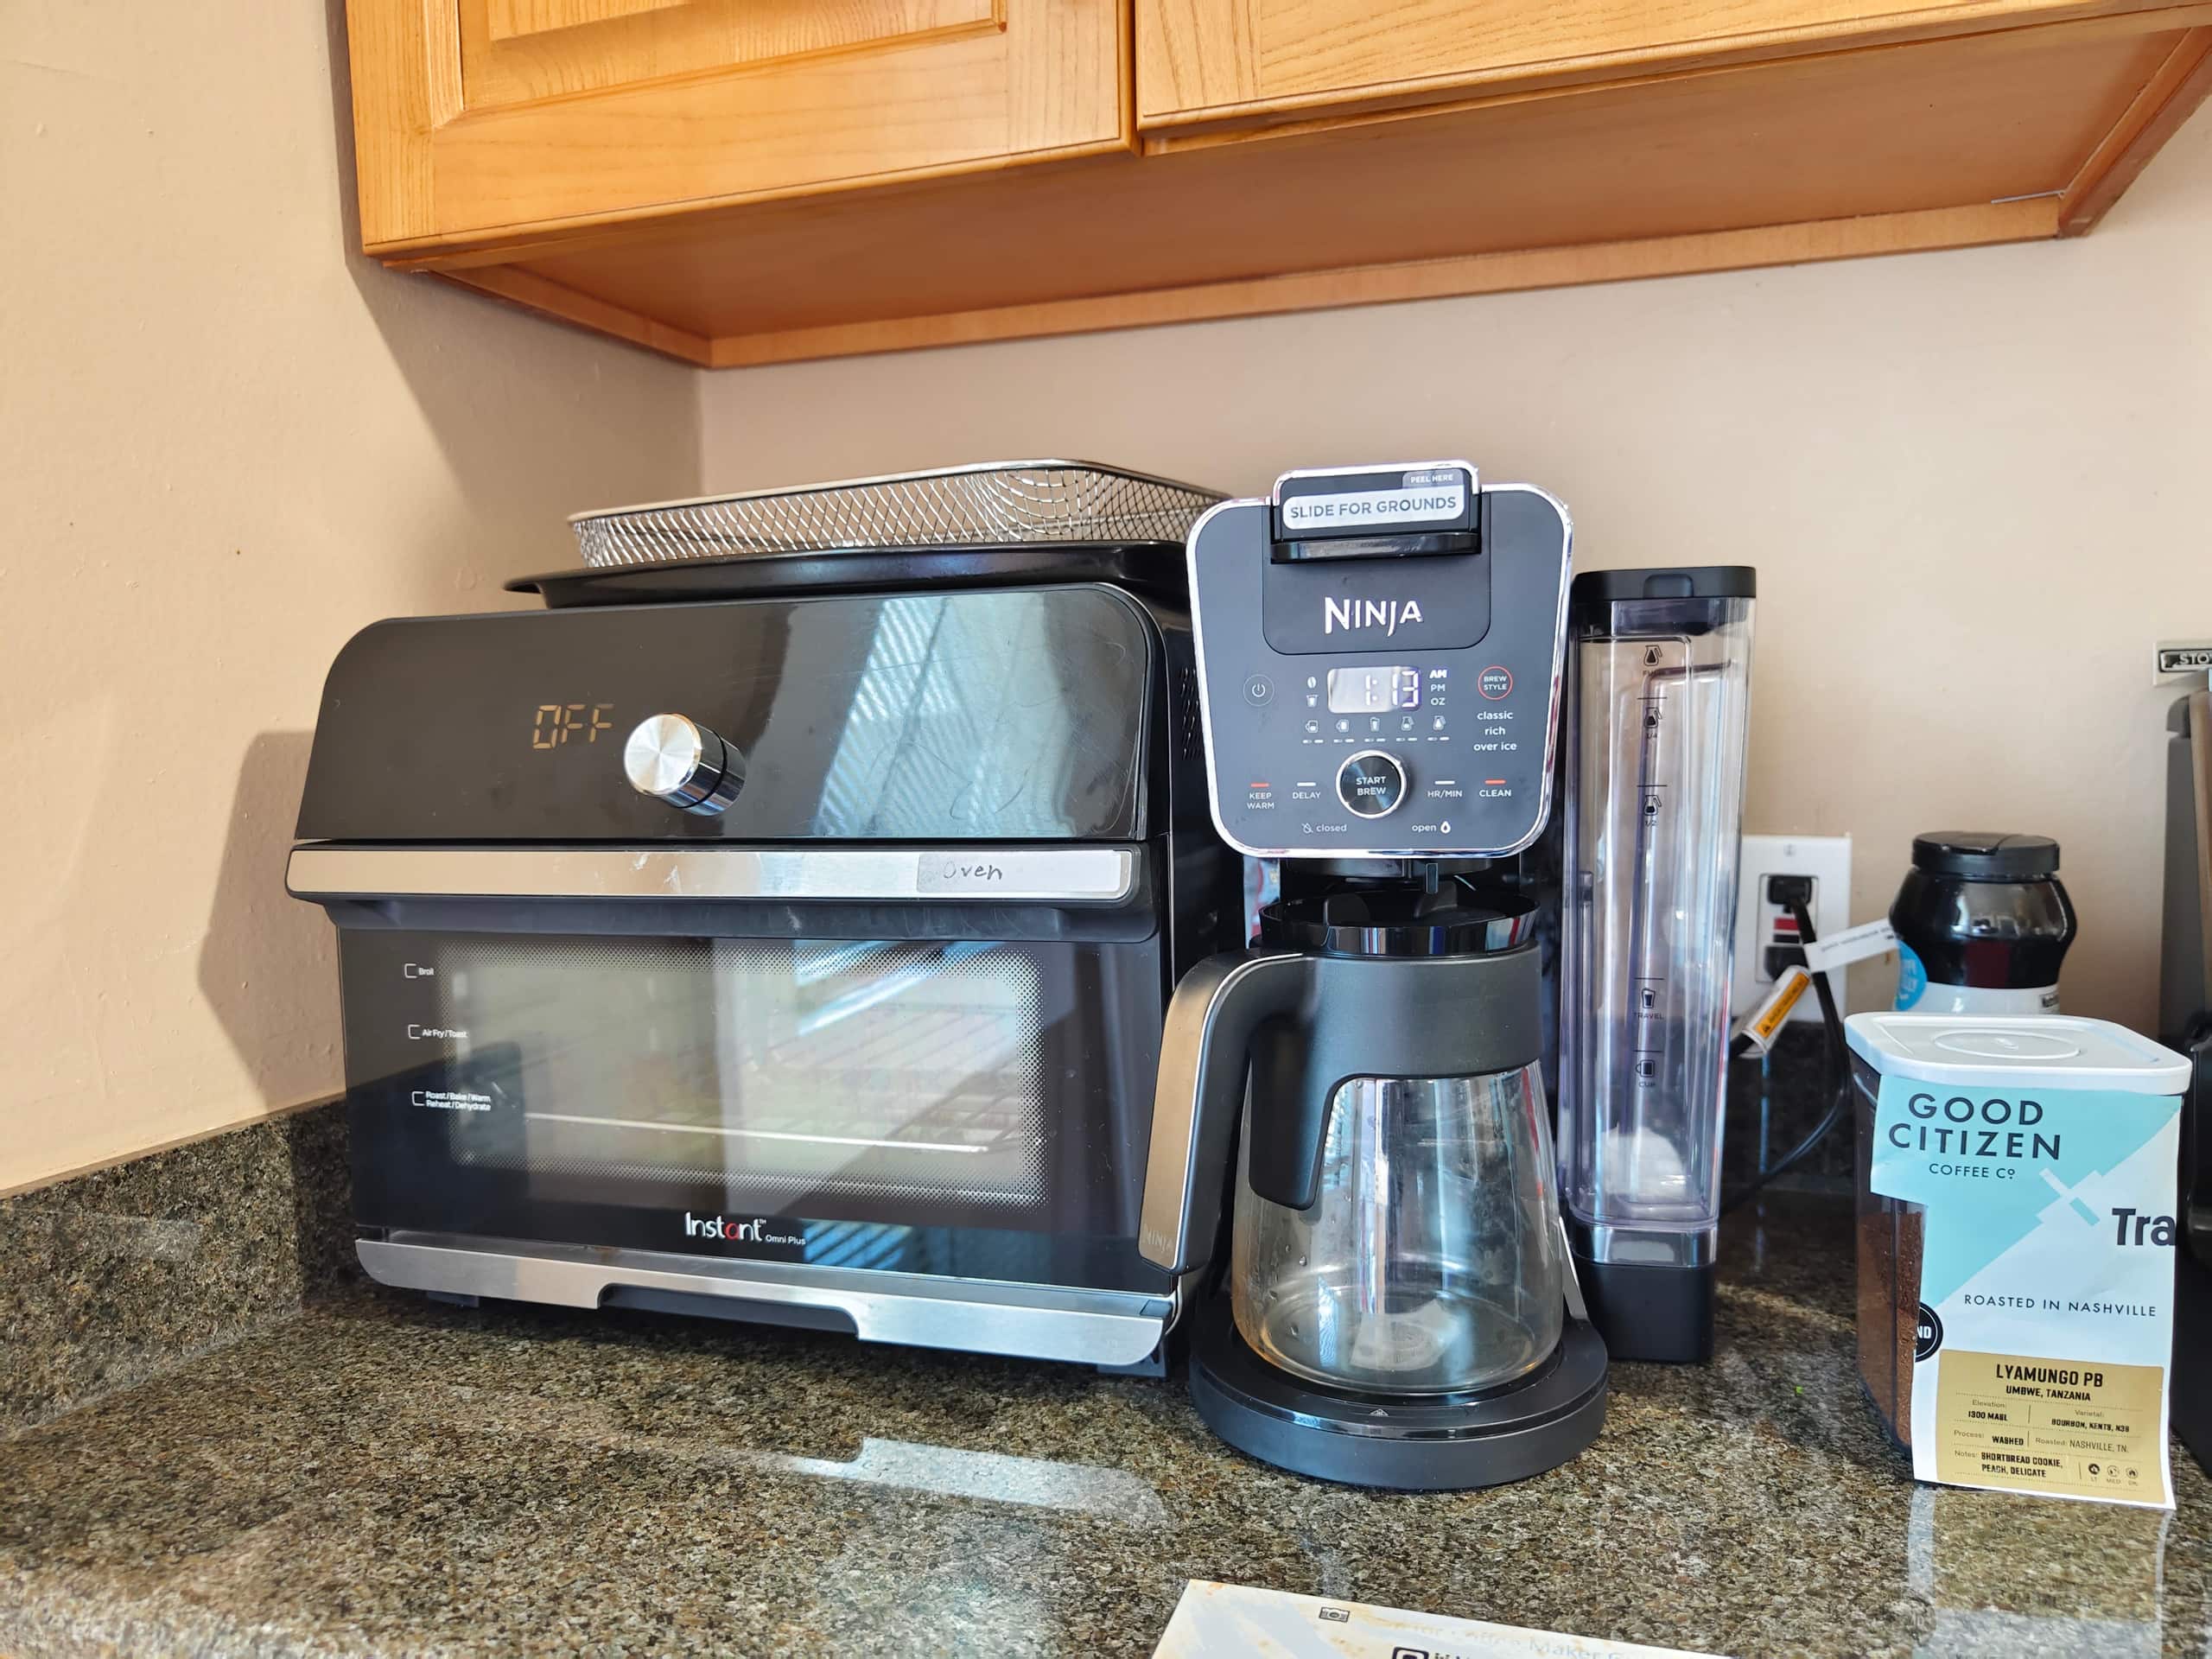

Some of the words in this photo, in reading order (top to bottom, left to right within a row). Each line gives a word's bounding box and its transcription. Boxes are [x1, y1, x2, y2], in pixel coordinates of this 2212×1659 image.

[1410, 474, 1431, 484] PEEL
[1432, 473, 1454, 482] HERE
[1290, 502, 1335, 519] SLIDE
[1338, 499, 1372, 516] FOR
[1376, 496, 1457, 513] GROUNDS
[1324, 596, 1424, 637] NINJA
[2179, 652, 2212, 664] STO
[1429, 669, 1448, 679] AM
[1430, 683, 1446, 692] PM
[1477, 709, 1515, 721] classic
[532, 703, 615, 750] OFF
[1484, 725, 1506, 736] rich
[1473, 743, 1498, 753] over
[1500, 741, 1517, 751] ice
[1356, 776, 1387, 785] START
[1249, 792, 1273, 801] KEEP
[1292, 791, 1321, 800] DELAY
[1357, 786, 1387, 797] BREW
[1427, 789, 1463, 799] HR/MIN
[1478, 789, 1512, 798] CLEAN
[1316, 823, 1348, 833] closed
[1411, 823, 1437, 835] open
[943, 861, 1003, 880] Oven
[1908, 1092, 2044, 1125] GOOD
[1888, 1123, 2060, 1160] CITIZEN
[1929, 1163, 1990, 1179] COFFEE
[2112, 1208, 2177, 1246] Tra
[766, 1234, 786, 1244] Omni
[788, 1236, 806, 1246] Plus
[1964, 1294, 2035, 1309] ROASTED
[2043, 1300, 2060, 1311] IN
[2068, 1301, 2158, 1318] NASHVILLE
[1996, 1363, 2079, 1386] LYAMUNGO
[2083, 1372, 2104, 1388] PB
[2005, 1385, 2044, 1398] UMBWE,
[2046, 1389, 2091, 1402] TANZANIA
[1968, 1410, 1986, 1420] 1300
[1992, 1435, 2024, 1446] WASHED
[1980, 1452, 2031, 1465] SHORTBREAD
[2032, 1456, 2063, 1469] COOKIE,
[2011, 1466, 2047, 1478] DELICATE
